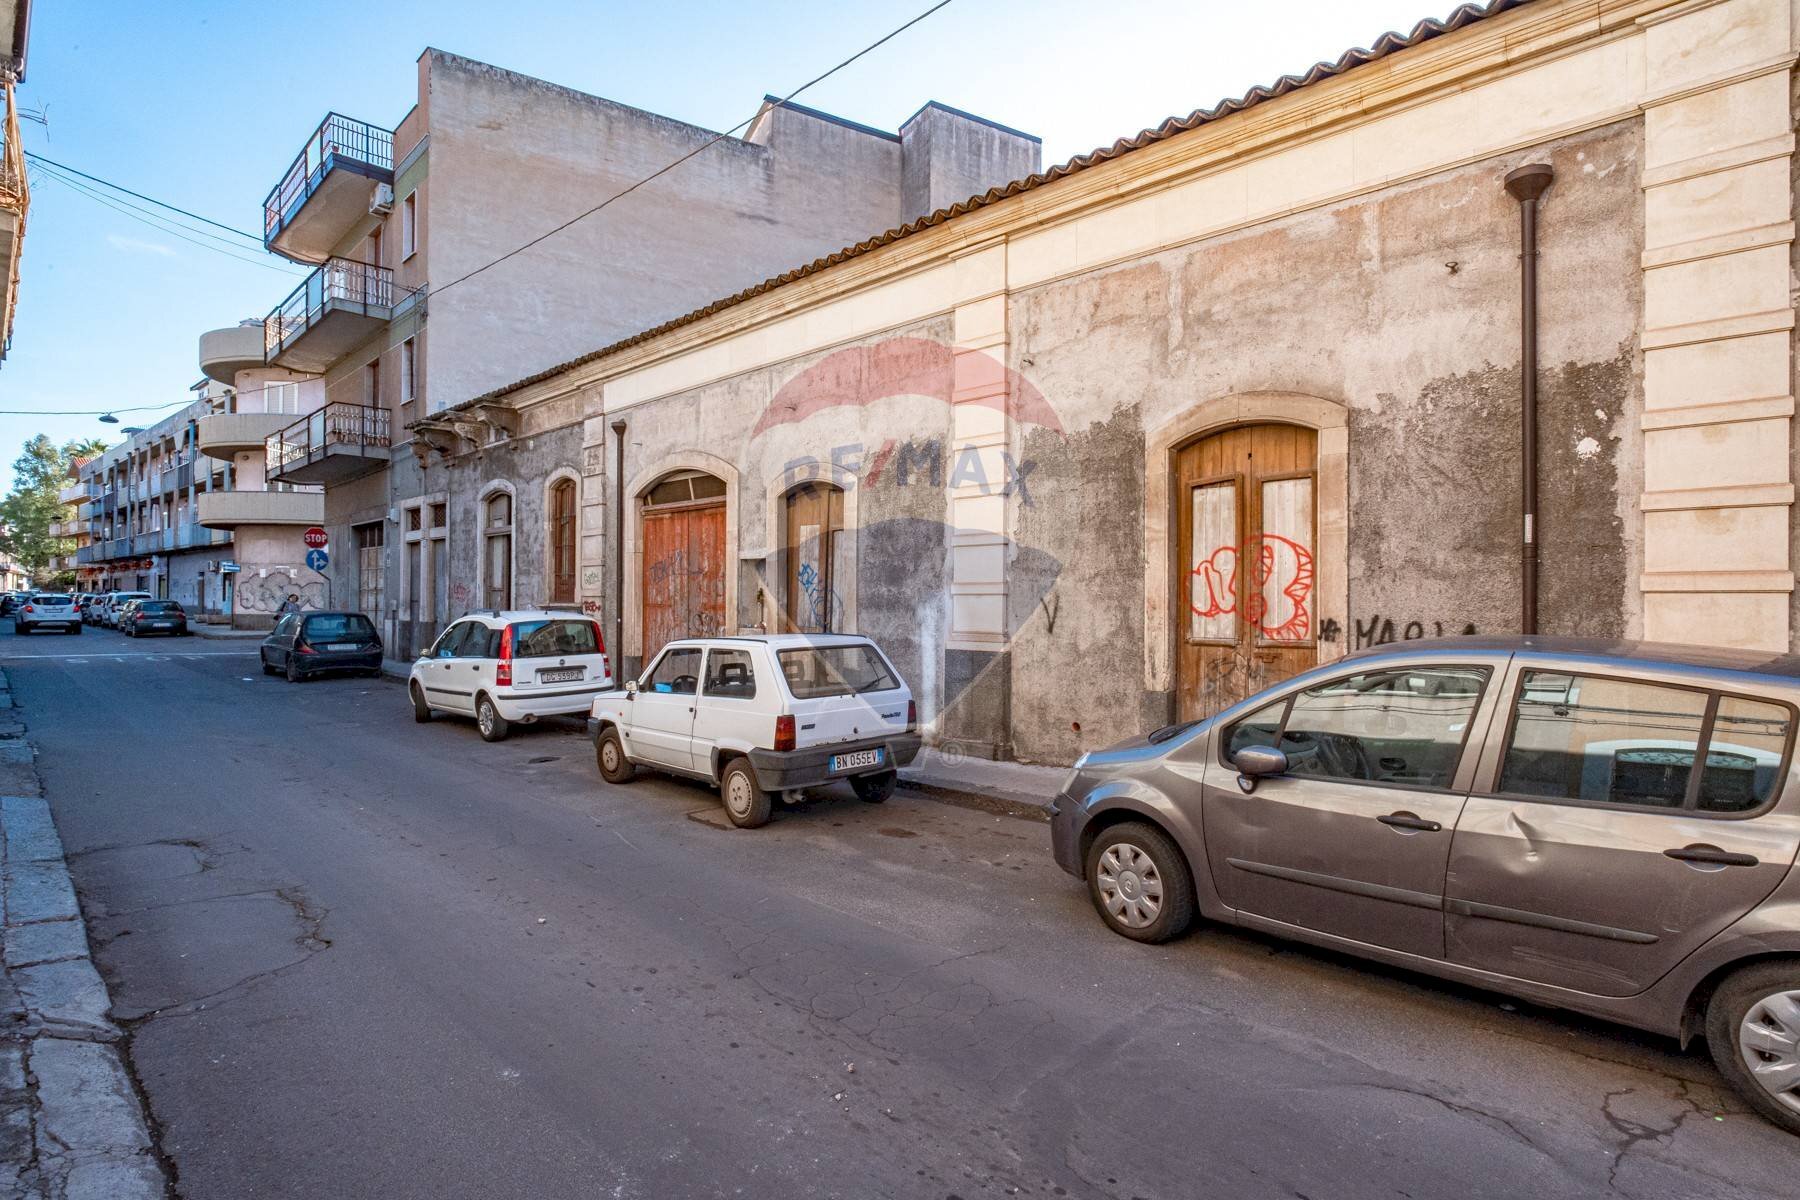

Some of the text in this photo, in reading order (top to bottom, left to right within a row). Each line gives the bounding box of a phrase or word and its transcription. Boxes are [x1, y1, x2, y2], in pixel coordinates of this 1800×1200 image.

[305, 534, 327, 543] STOP
[836, 751, 878, 769] BN 055EV
